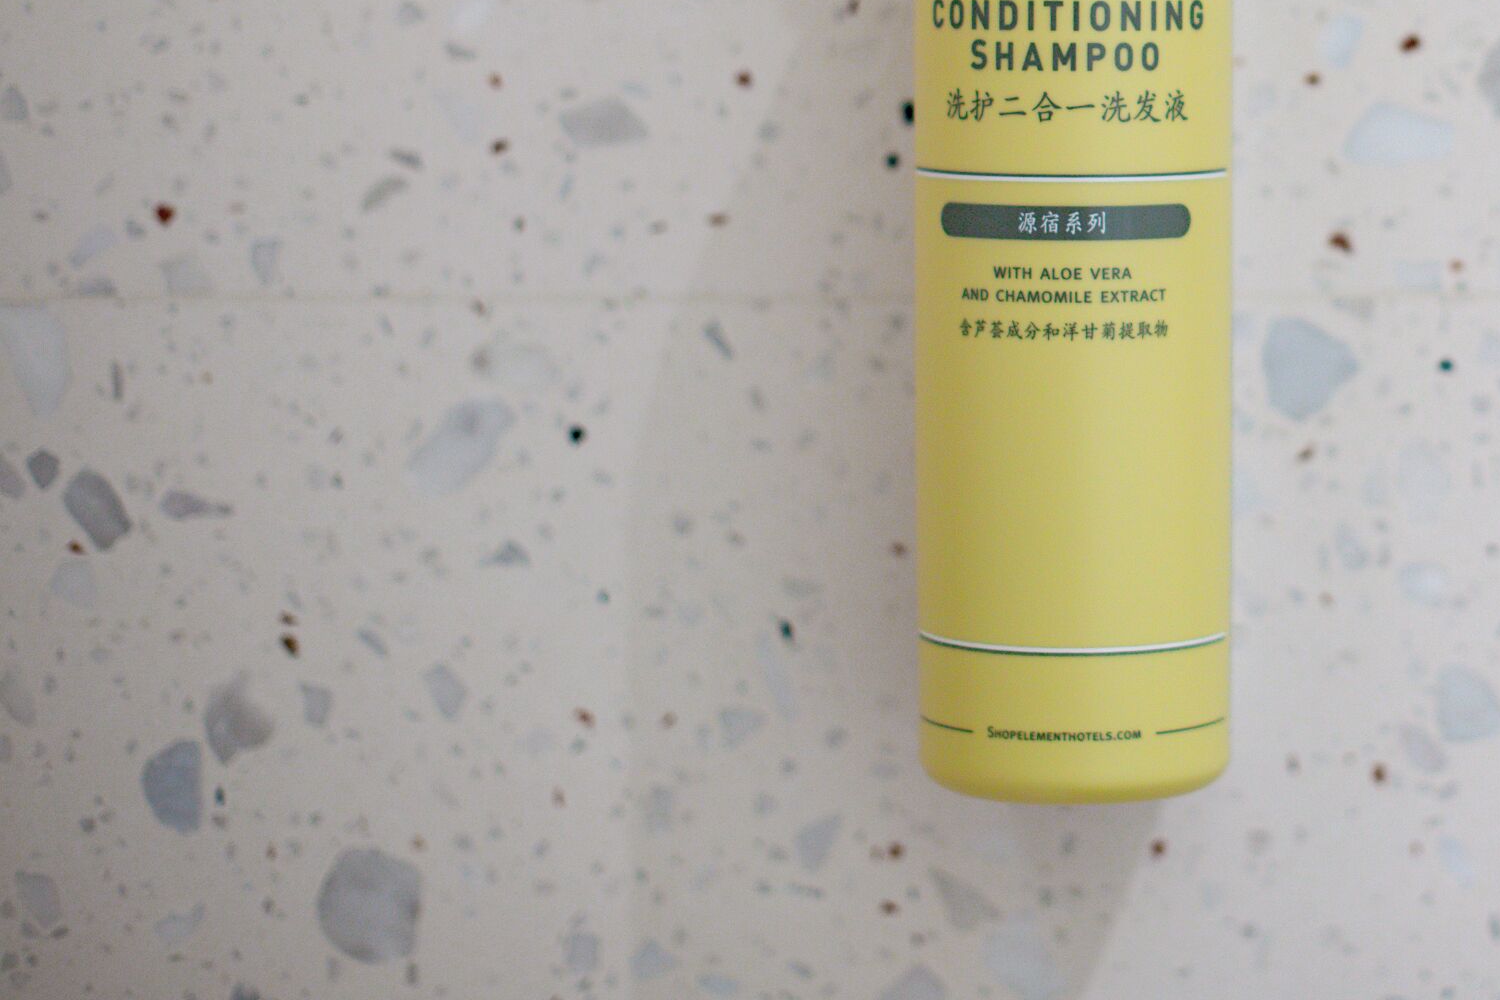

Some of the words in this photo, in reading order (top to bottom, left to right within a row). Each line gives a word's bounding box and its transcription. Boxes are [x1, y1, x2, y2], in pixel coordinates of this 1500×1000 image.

[970, 39, 1159, 72] SHAMPOO
[946, 87, 1189, 123] 洗护二合一洗发液
[1018, 211, 1107, 235] 源宿系列
[993, 266, 1032, 280] WITH
[1040, 267, 1082, 280] ALOE
[1090, 267, 1132, 280] VERA
[961, 288, 989, 301] AND
[995, 289, 1092, 304] CHAMOMILE
[1100, 288, 1166, 303] EXTRACT
[959, 318, 1169, 341] 含芦荟成分和洋甘菊提取物
